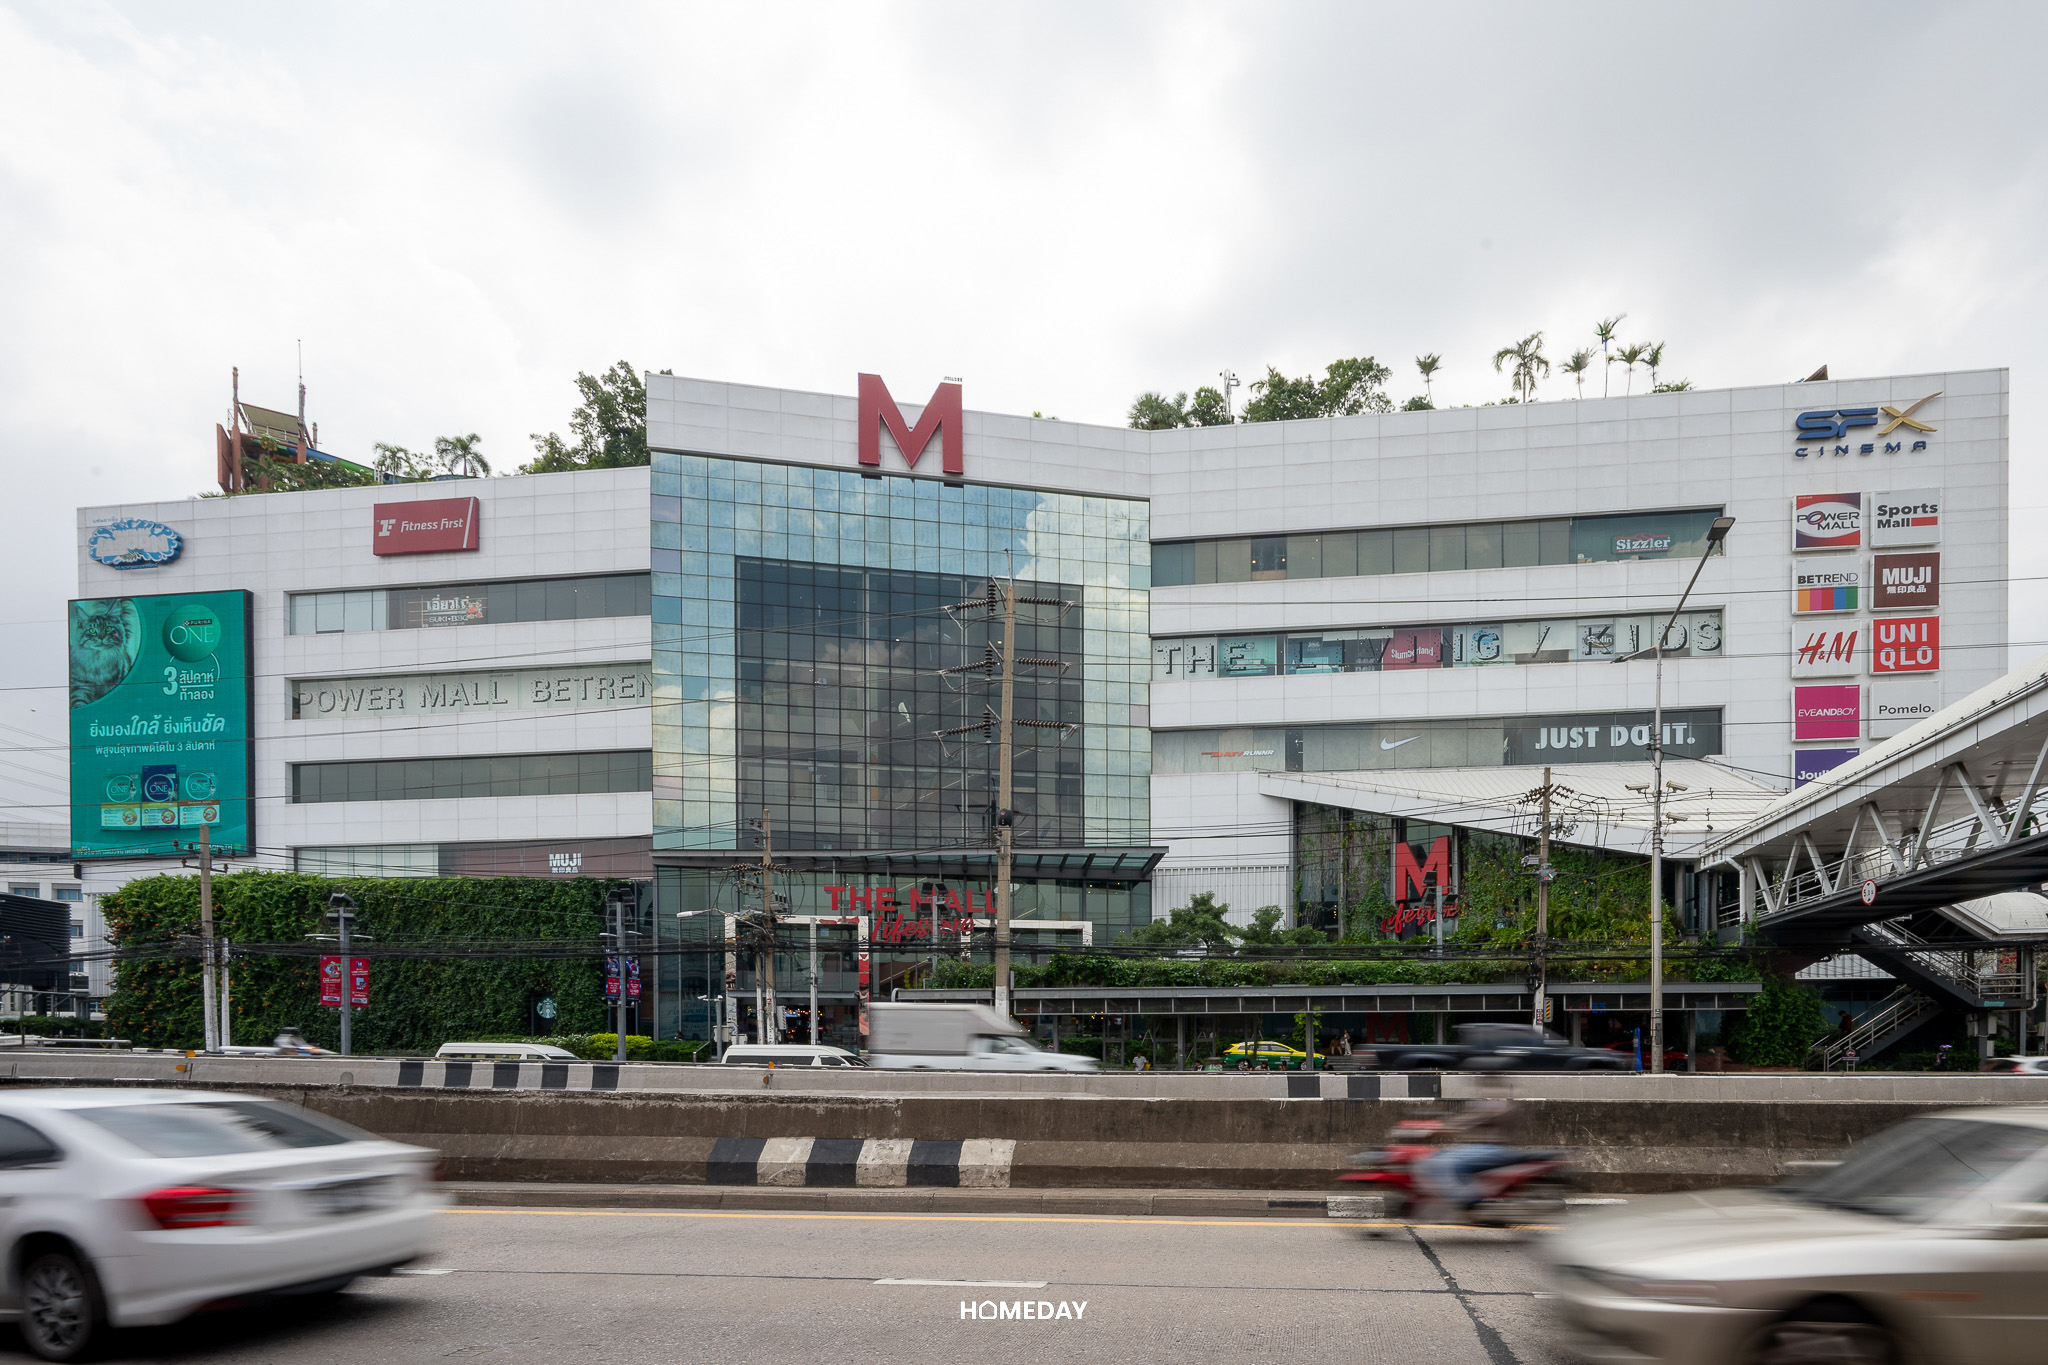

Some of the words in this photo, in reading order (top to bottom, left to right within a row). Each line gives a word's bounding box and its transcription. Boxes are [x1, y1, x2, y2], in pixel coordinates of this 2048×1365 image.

[858, 372, 963, 475] M
[1796, 391, 1944, 440] SFX
[1795, 440, 1927, 457] CINEMA
[1797, 511, 1860, 525] POWER
[1877, 503, 1938, 518] Sports
[1817, 521, 1860, 531] MALL
[1877, 517, 1910, 529] Mall
[1616, 537, 1670, 550] Sizzler
[1798, 573, 1858, 584] BETREND
[1882, 566, 1932, 585] MUJI
[1887, 585, 1926, 594] 無印良品
[170, 625, 214, 645] ONE
[1880, 623, 1928, 643] UNI
[1798, 630, 1858, 665] H&M
[1880, 646, 1932, 669] QLO
[1155, 642, 1247, 675] THE
[162, 666, 178, 696] 3
[295, 688, 405, 714] POWER
[420, 681, 509, 708] MALL
[1798, 707, 1856, 718] EVEANDBOY
[1879, 704, 1935, 715] Pomelo.
[1535, 727, 1600, 749] JUST
[1662, 723, 1696, 744] IT.
[549, 853, 582, 867] MUJI
[1395, 835, 1450, 901] M
[824, 886, 896, 911] THE
[872, 913, 976, 942] Lifesore
